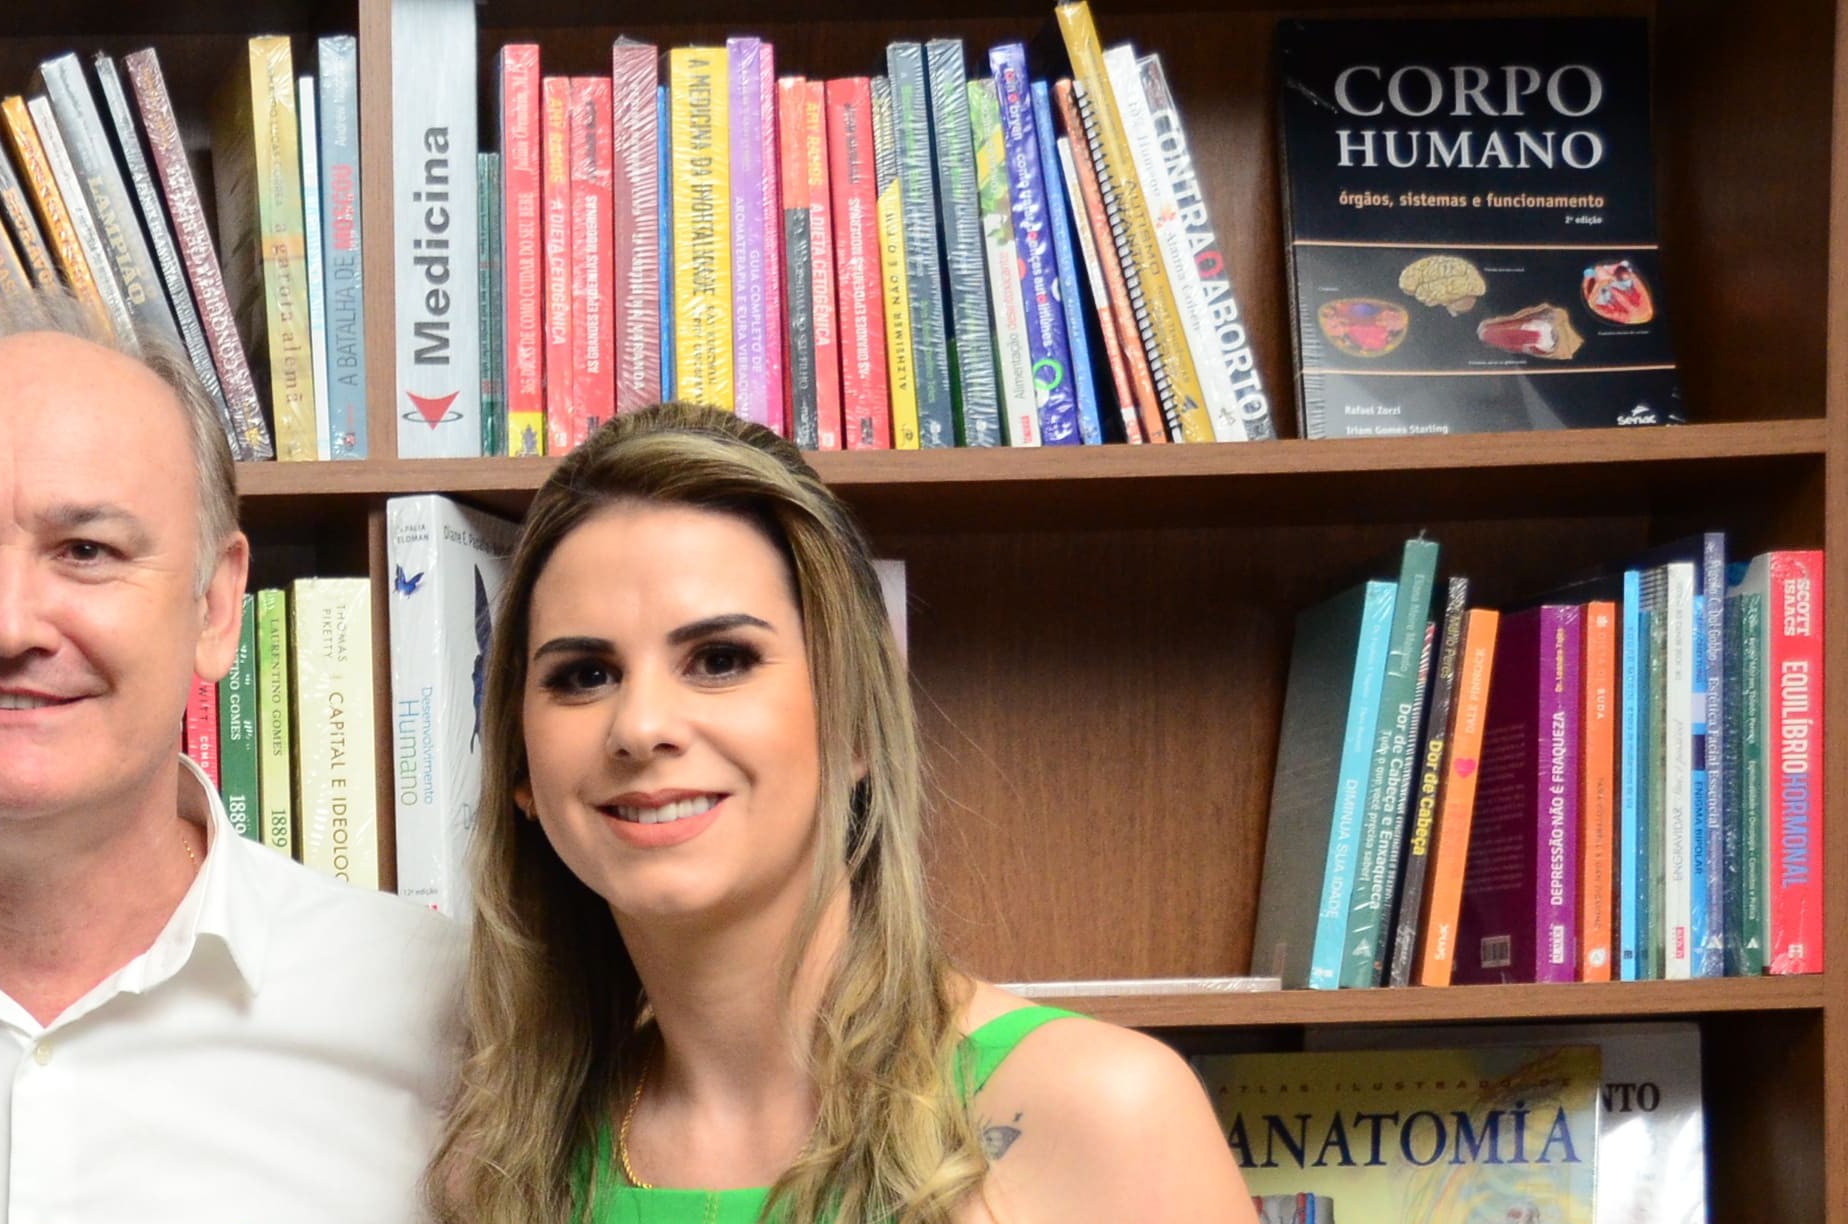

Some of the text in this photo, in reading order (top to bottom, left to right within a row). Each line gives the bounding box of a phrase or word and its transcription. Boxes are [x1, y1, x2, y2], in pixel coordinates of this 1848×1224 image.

[687, 74, 712, 149] MEDICINA
[1333, 64, 1604, 117] CORPO
[1336, 130, 1604, 169] HUMANO
[1339, 189, 1604, 209] órgãos, sistemas e funcionamento
[1575, 215, 1603, 227] edição
[80, 173, 155, 307] LAMPIÃO
[413, 126, 450, 365] Medicina
[548, 214, 569, 344] DIETA CETOGÊNICA
[734, 196, 747, 292] AROMATERAPIA
[270, 243, 294, 323] garota
[333, 255, 358, 385] A BATALHA DE
[748, 249, 762, 352] GUIA COMPLETO
[809, 217, 831, 346] DIETA CETOGÊNICA
[1003, 331, 1029, 400] Alimentação
[1199, 277, 1269, 421] ABORTO
[322, 608, 334, 660] PIKETTY
[336, 604, 348, 663] THOMAS
[1783, 579, 1797, 636] ISAACS
[1796, 579, 1810, 635] SCOTT
[230, 697, 242, 741] GOMES
[271, 618, 283, 756] LAURENTINO GOMES
[328, 691, 348, 772] CAPITAL
[398, 698, 419, 806] Humano
[421, 687, 434, 806] Desenvolvimento
[229, 794, 246, 835] 1889
[271, 808, 288, 848] 1889
[1368, 702, 1411, 911] Dor de Cabeça e Enxaqueca
[1410, 738, 1442, 856] Dor de Cabeça
[1548, 711, 1566, 905] DEPRESSÃO NÃO FRAQUEZA
[1229, 1101, 1582, 1169] ANATOMÍA
